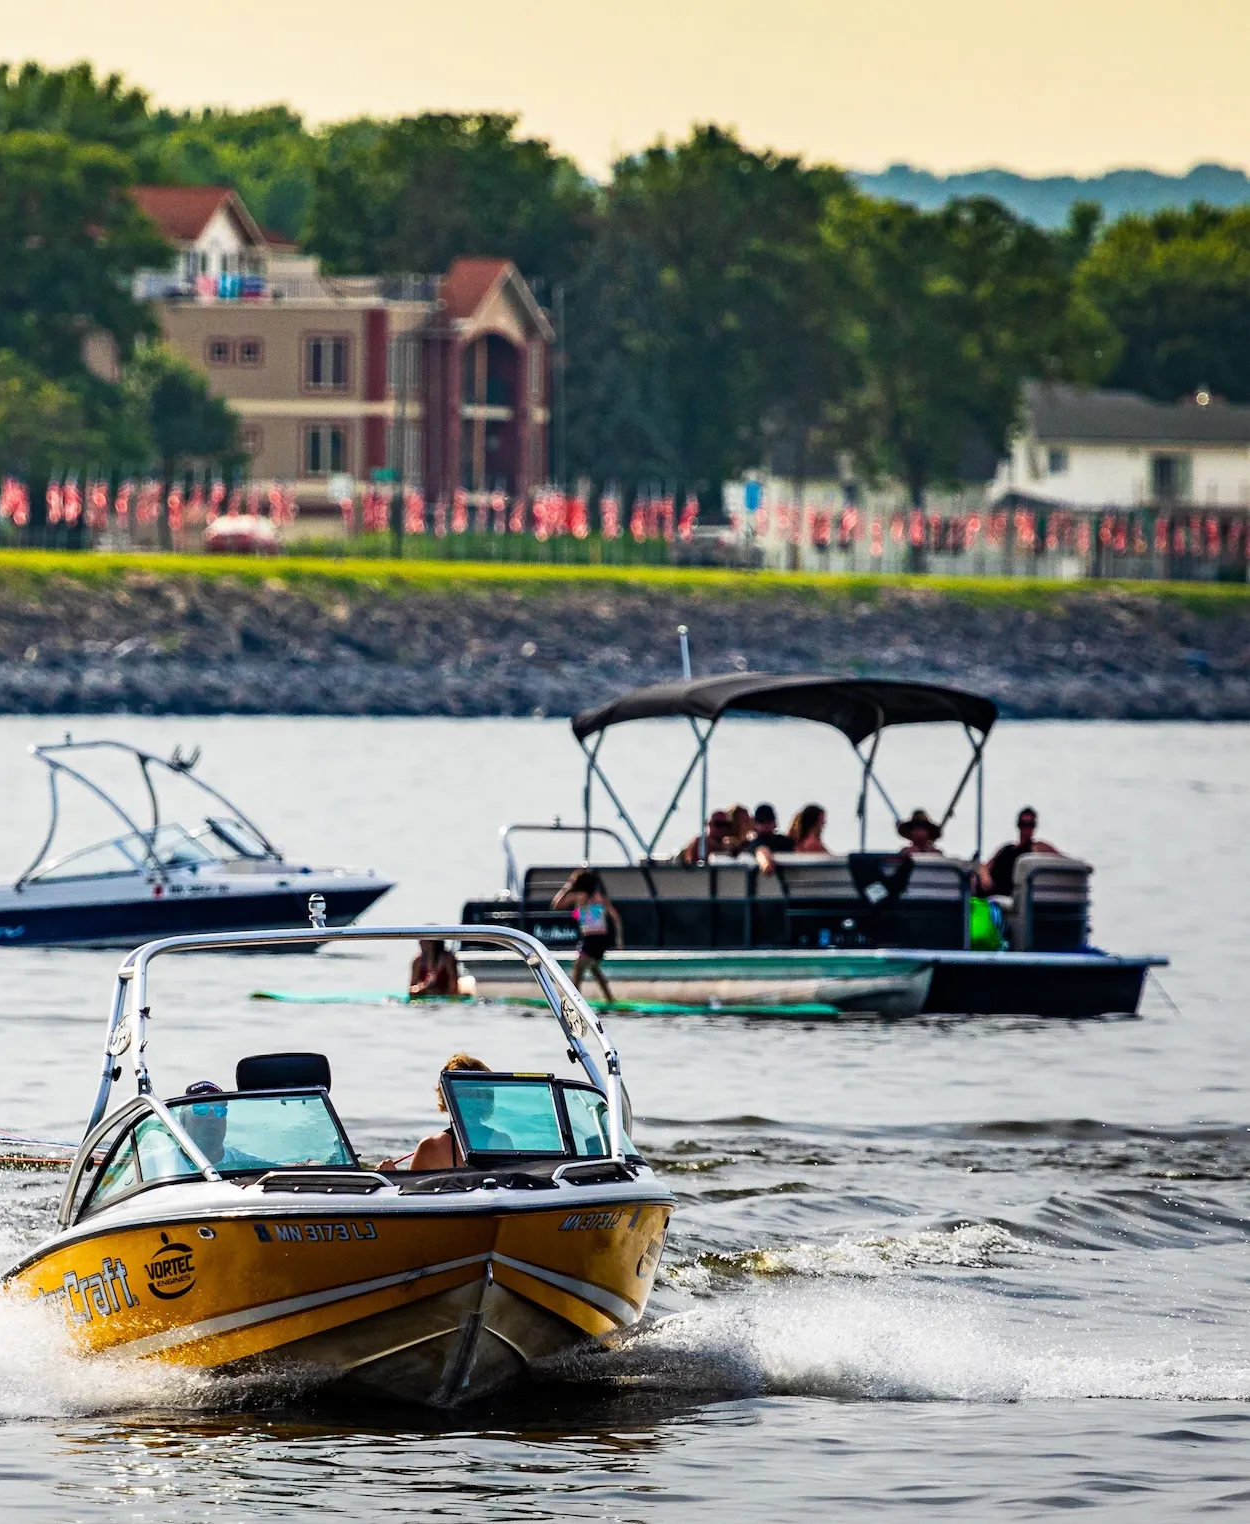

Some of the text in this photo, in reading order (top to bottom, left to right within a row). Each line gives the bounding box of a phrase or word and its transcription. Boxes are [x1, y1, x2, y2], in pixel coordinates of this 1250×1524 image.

[273, 1221, 377, 1242] MN 3173 LJ
[144, 1253, 195, 1280] VORTEC
[157, 1274, 191, 1287] ENGINES
